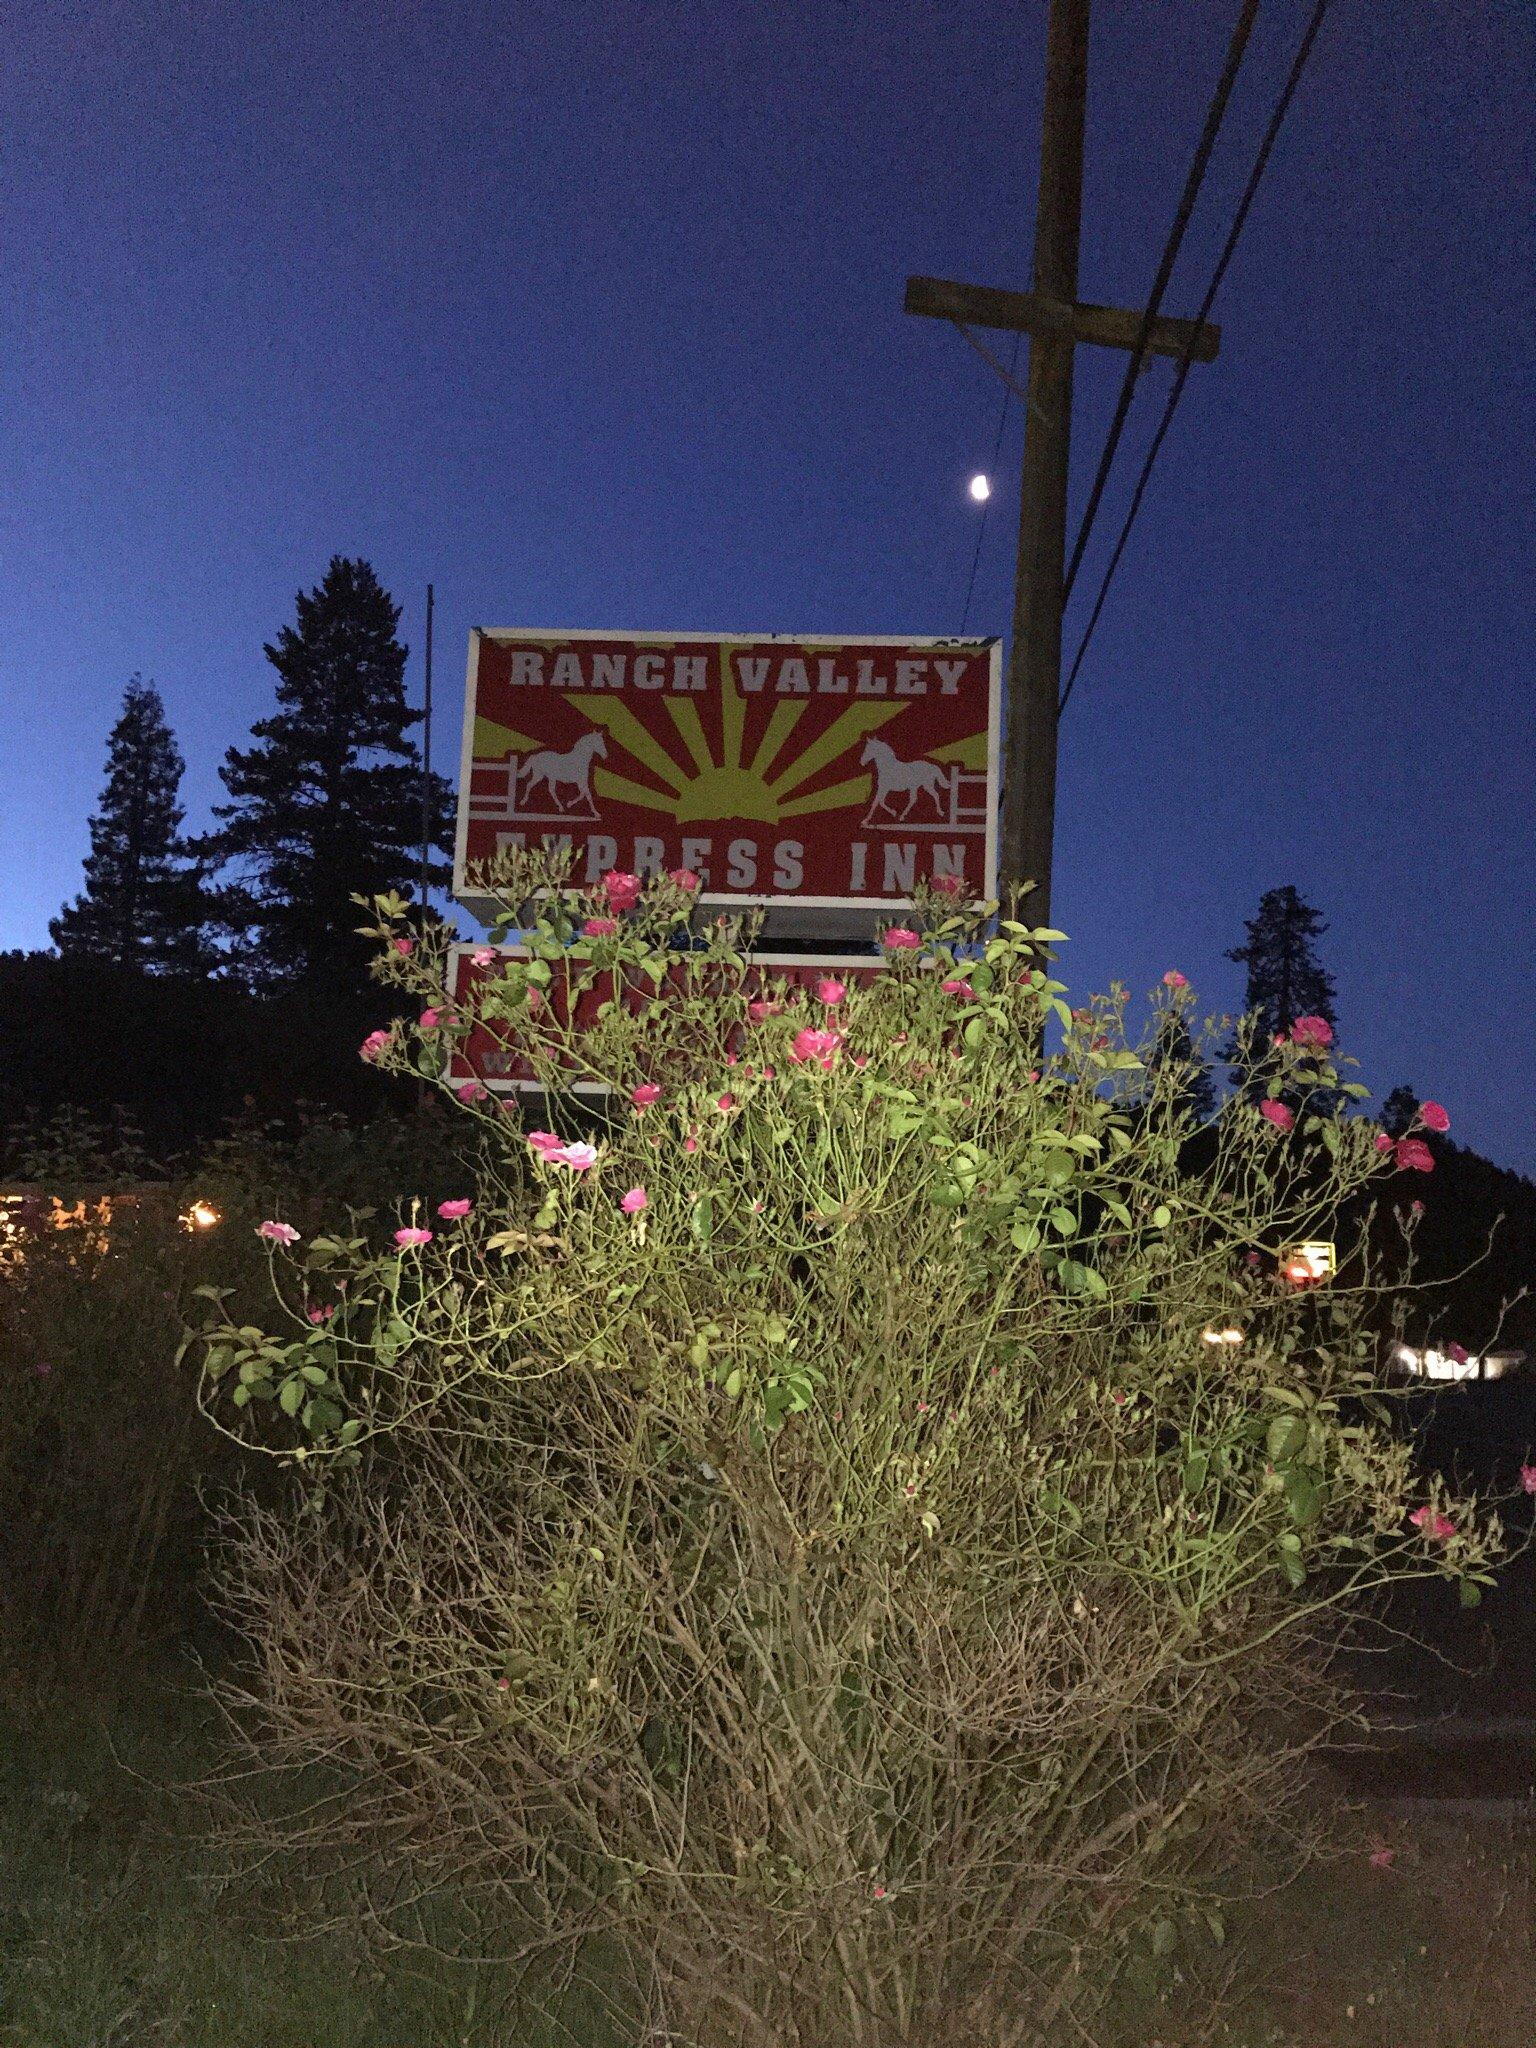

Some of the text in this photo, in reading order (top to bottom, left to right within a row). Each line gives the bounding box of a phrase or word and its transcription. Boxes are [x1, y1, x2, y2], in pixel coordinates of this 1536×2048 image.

[509, 651, 968, 695] RANCH VALLEY
[850, 842, 967, 892] INN
